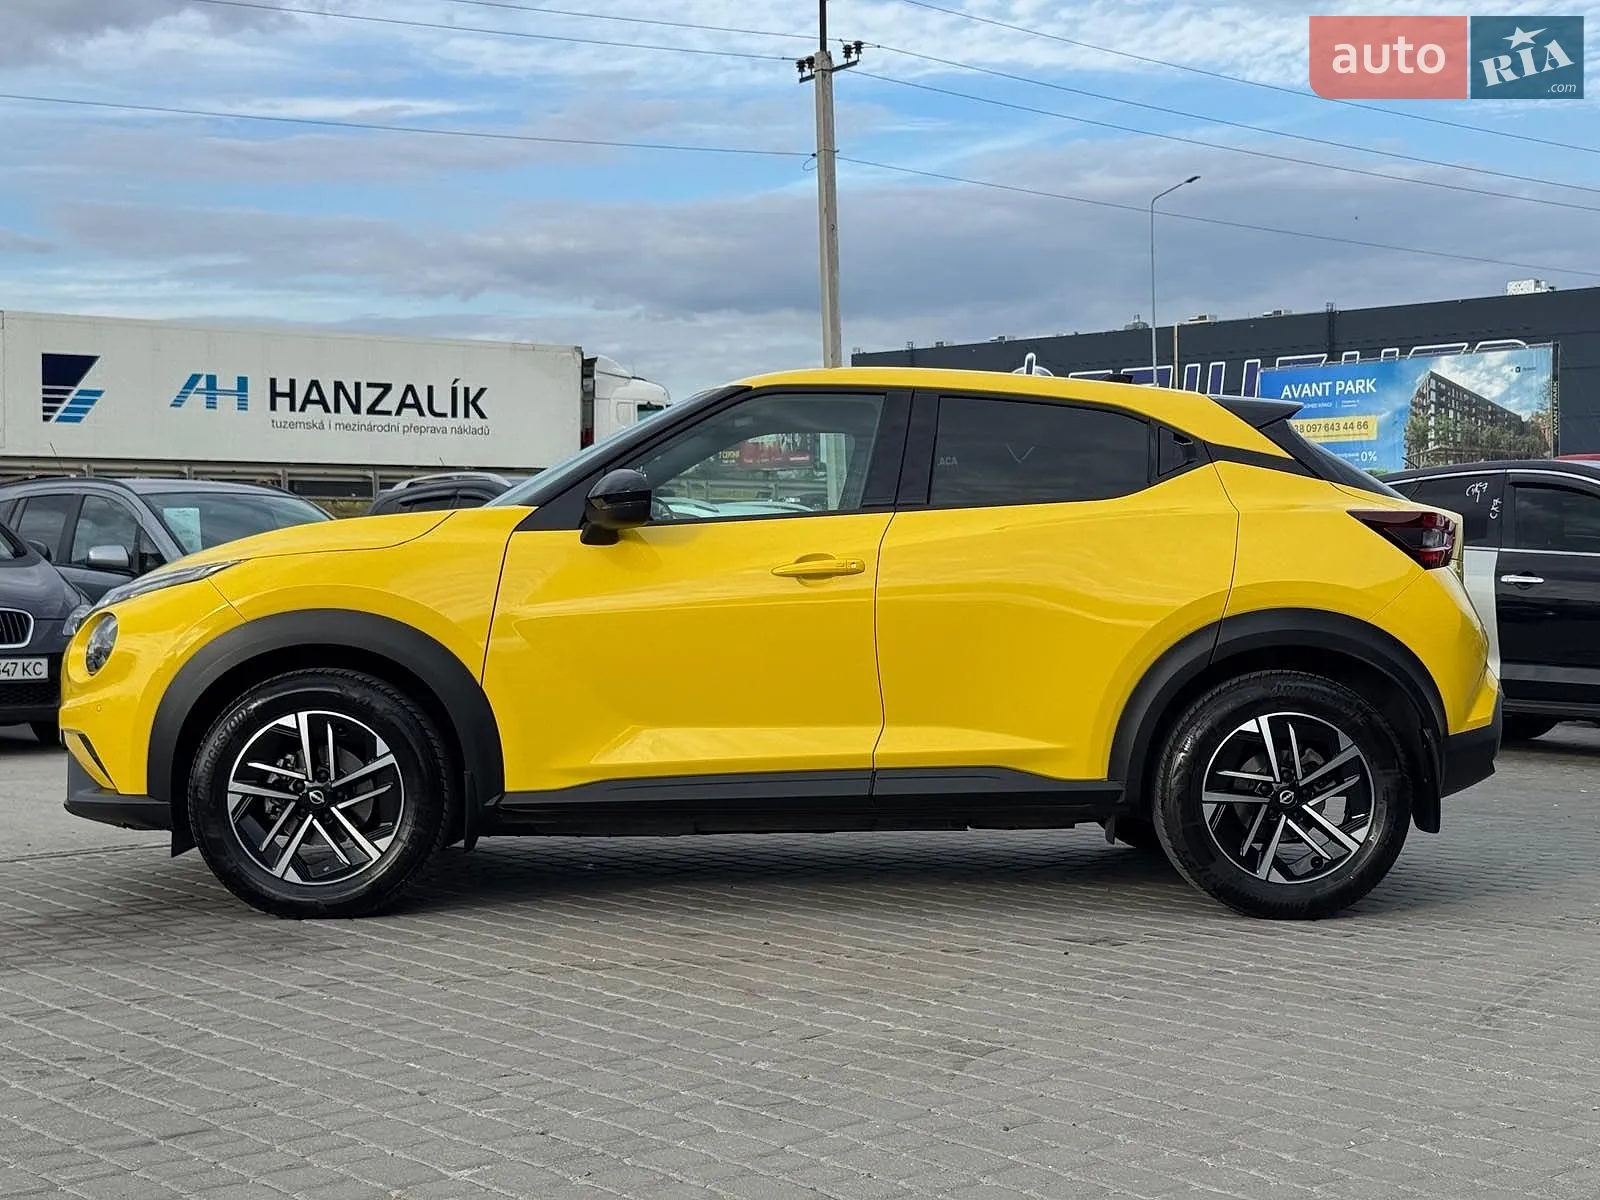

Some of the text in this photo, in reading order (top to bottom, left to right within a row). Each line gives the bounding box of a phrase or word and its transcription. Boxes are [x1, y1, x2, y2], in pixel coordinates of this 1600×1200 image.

[1280, 378, 1377, 399] AVANT PARK
[269, 377, 488, 419] HANZALÍK
[271, 419, 325, 431] tuzemská
[334, 421, 400, 433] mezinárodní
[403, 423, 448, 436] přeprava
[450, 424, 490, 436] nákladů
[1306, 423, 1322, 433] 097
[1324, 422, 1341, 432] 643
[1342, 421, 1355, 431] 44
[1356, 420, 1369, 430] 66
[1360, 450, 1377, 461] 0%
[22, 661, 43, 677] KC
